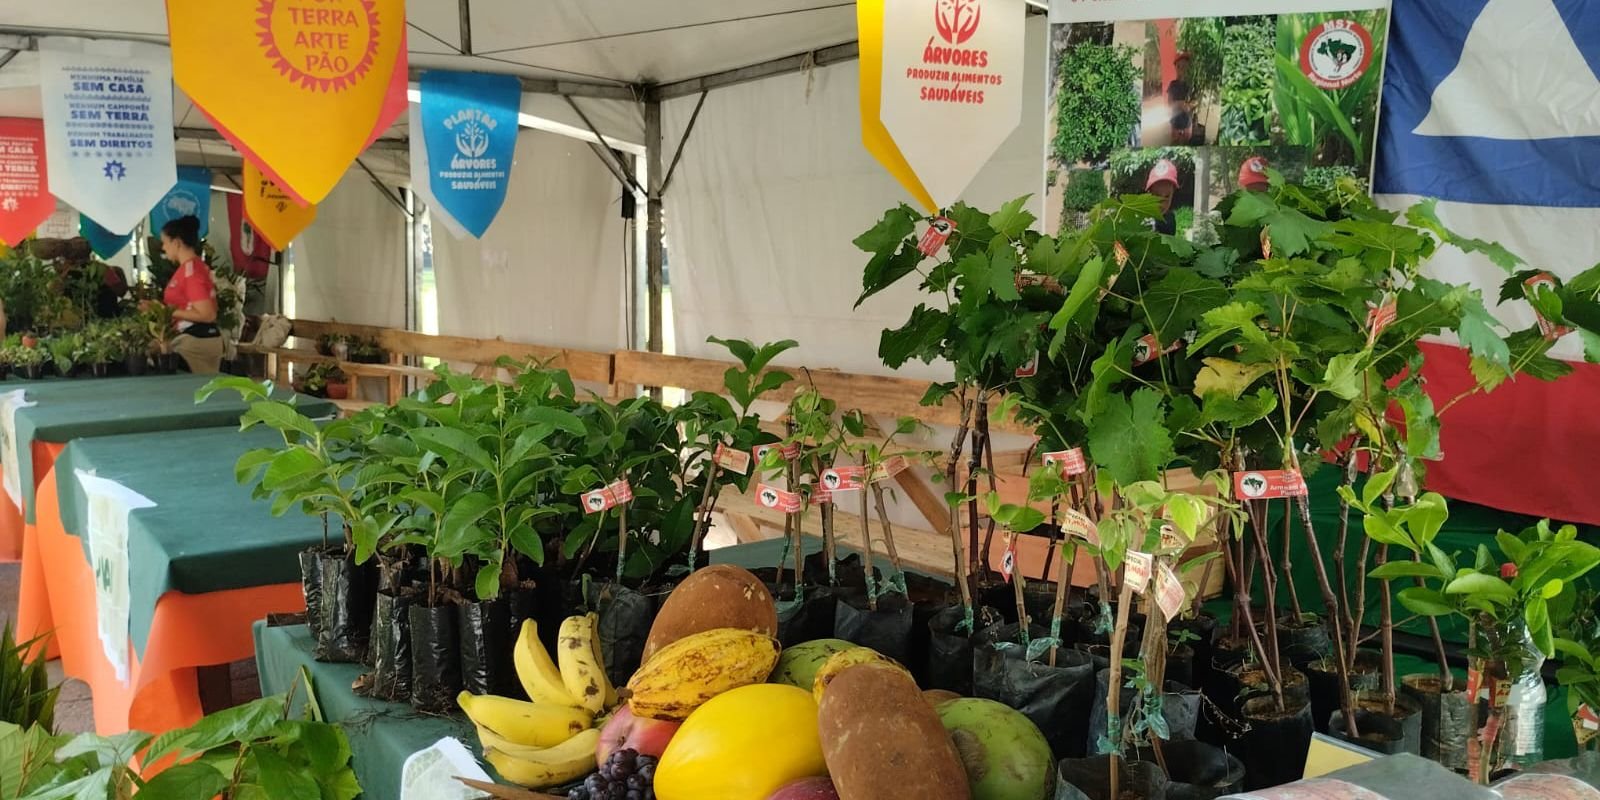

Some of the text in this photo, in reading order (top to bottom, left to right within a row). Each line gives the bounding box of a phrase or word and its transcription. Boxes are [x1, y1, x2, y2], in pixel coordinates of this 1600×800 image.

[288, 7, 359, 28] TERRA
[1323, 19, 1355, 30] MST
[295, 31, 349, 49] ARTE
[923, 36, 988, 68] ÁRVORES
[305, 51, 349, 73] PÃO
[906, 68, 1002, 85] PRODUZIR ALIMENTOS
[73, 82, 144, 94] SEM CASA
[920, 82, 984, 104] SAUDÁVEIS
[71, 110, 149, 122] SEM TERRA
[443, 109, 497, 130] PLANTAR
[69, 139, 153, 149] SEM DIREITOS
[450, 153, 497, 170] ÁRVORES
